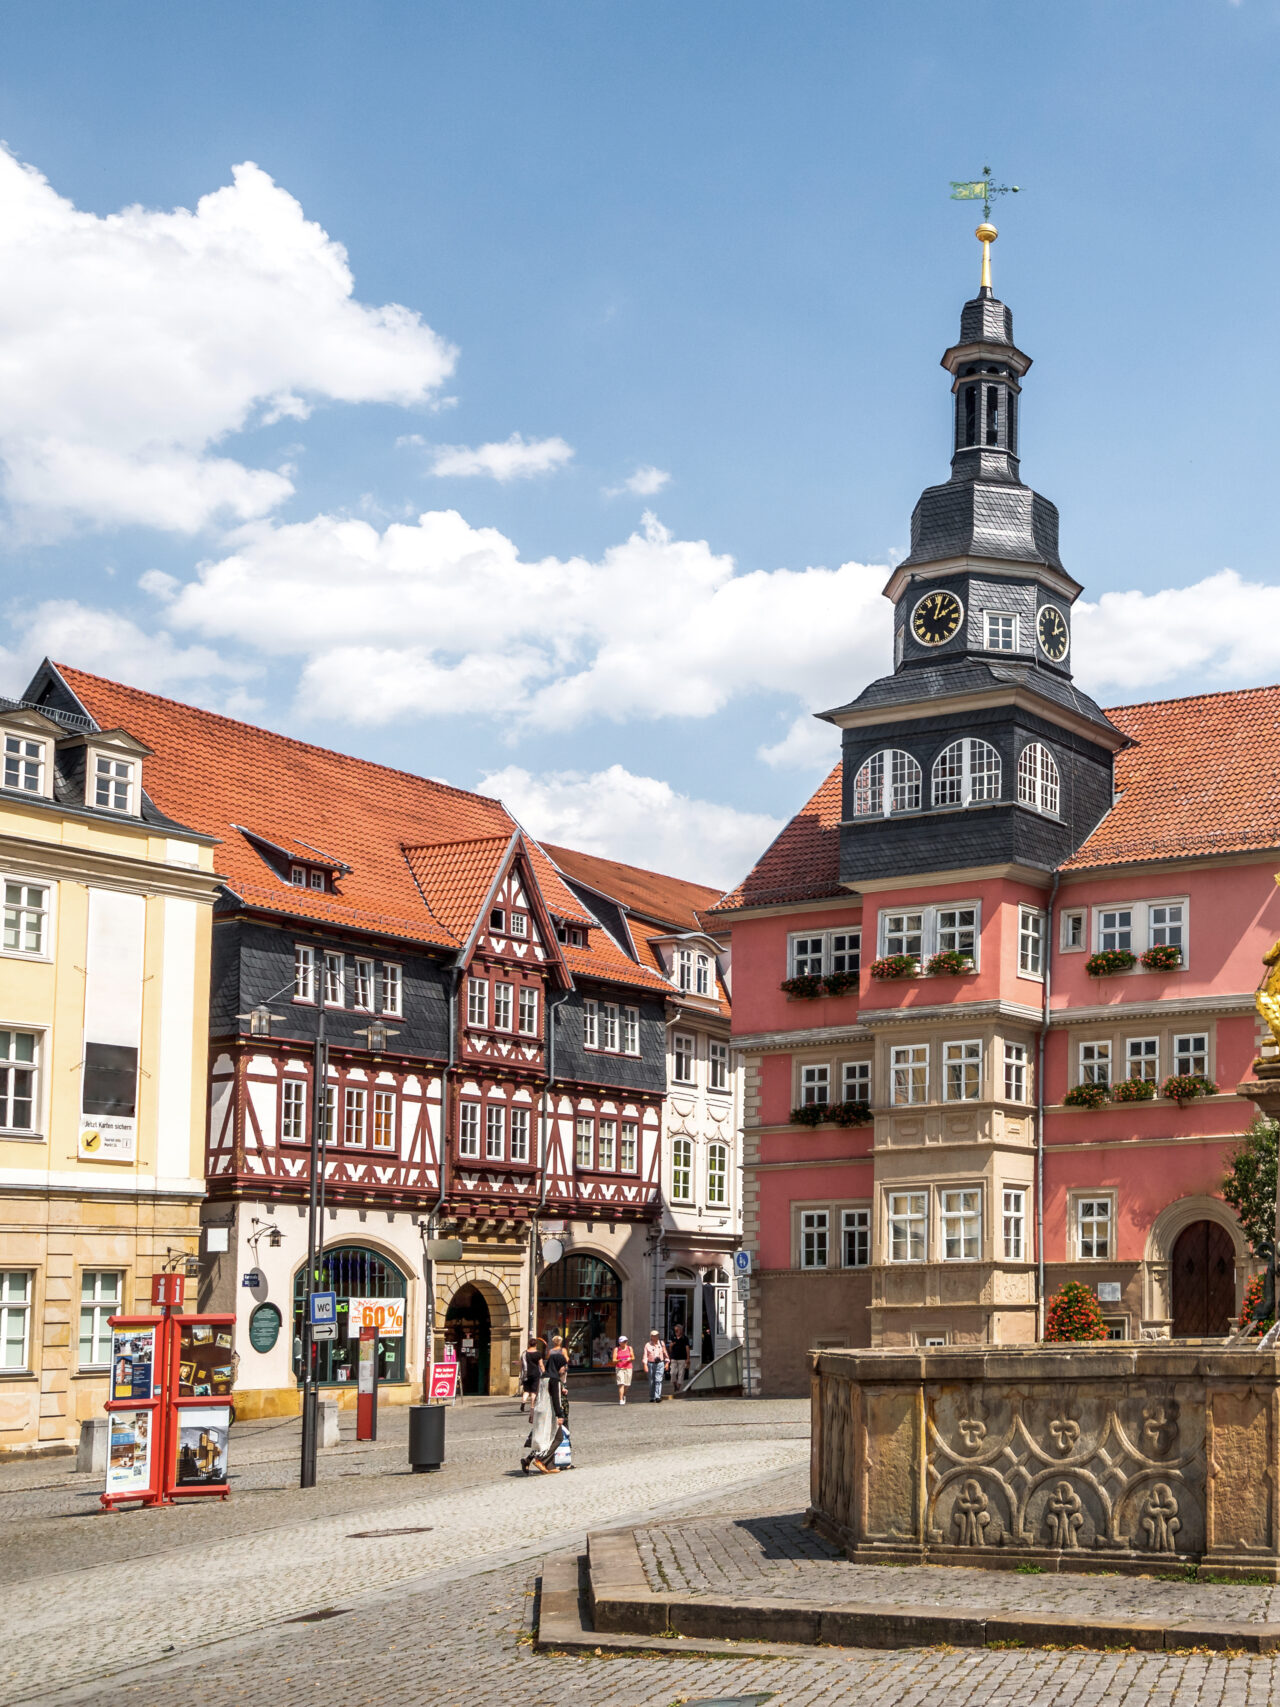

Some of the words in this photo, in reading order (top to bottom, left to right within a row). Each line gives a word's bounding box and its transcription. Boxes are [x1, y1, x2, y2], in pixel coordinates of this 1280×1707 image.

[84, 1120, 97, 1128] Jetzt
[98, 1121, 114, 1129] Karten
[317, 1303, 331, 1312] WC
